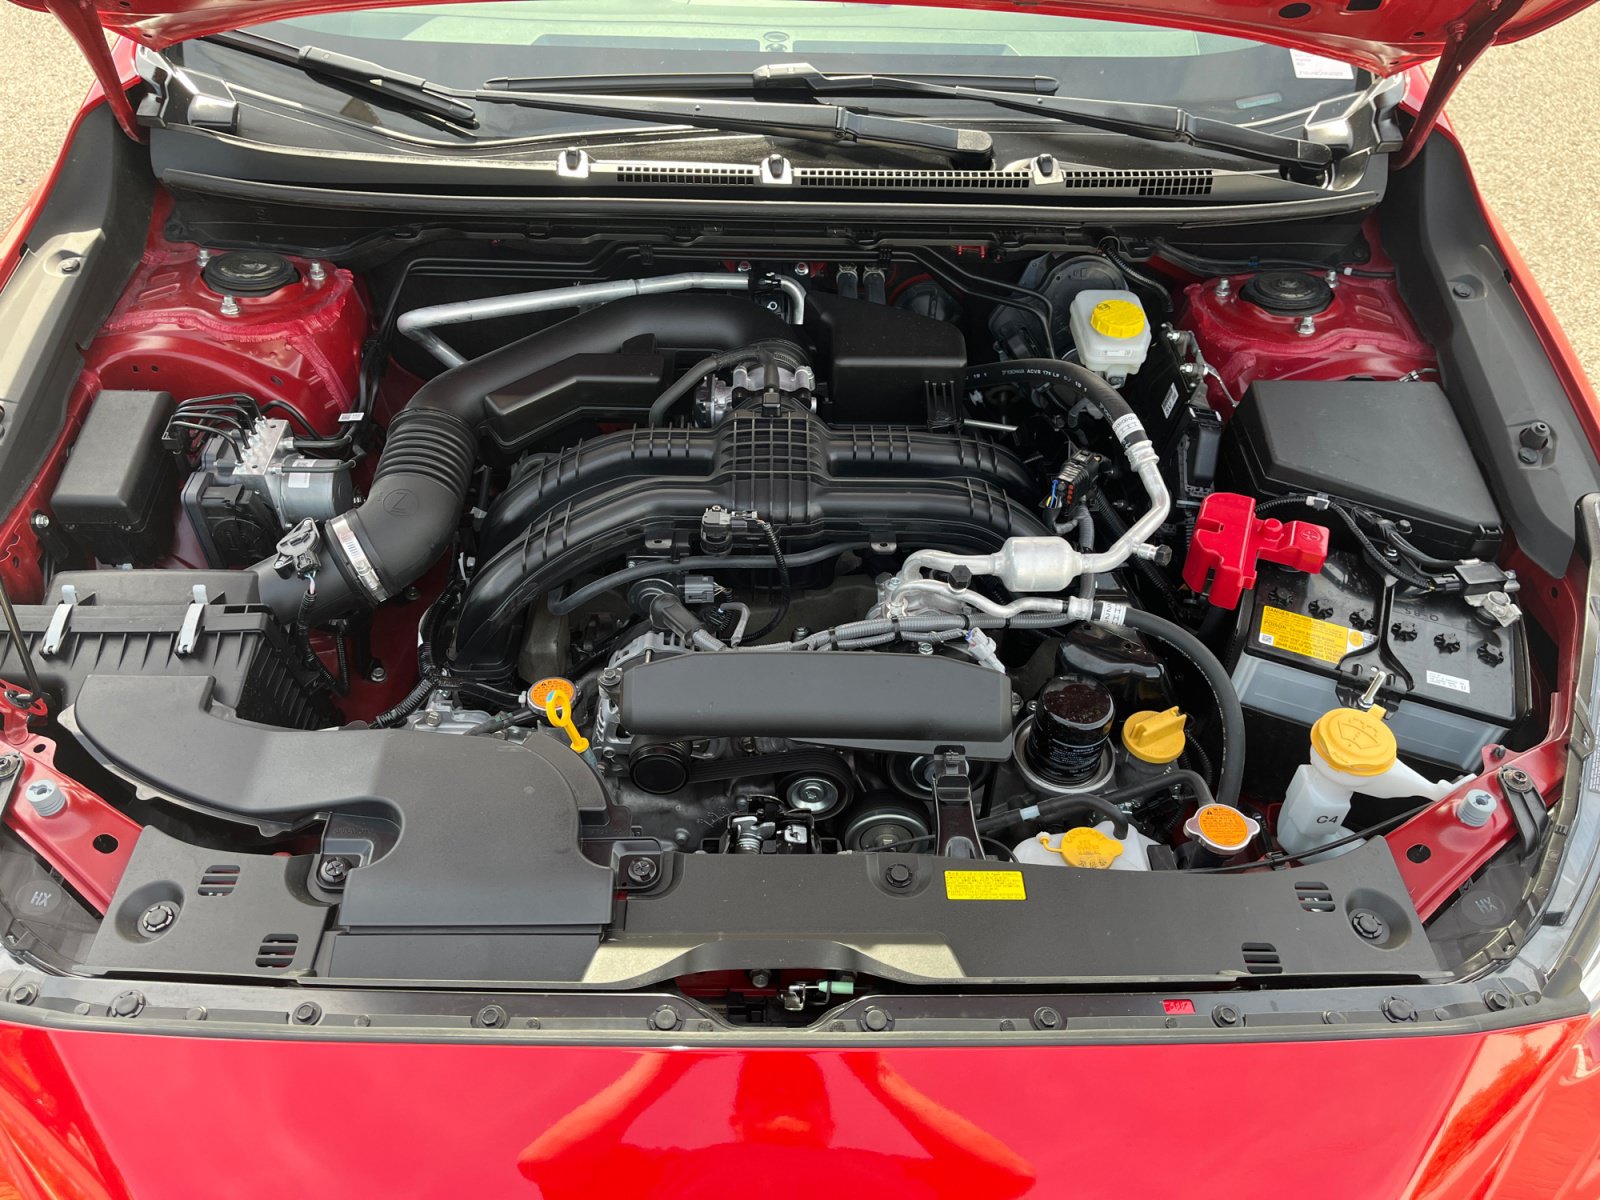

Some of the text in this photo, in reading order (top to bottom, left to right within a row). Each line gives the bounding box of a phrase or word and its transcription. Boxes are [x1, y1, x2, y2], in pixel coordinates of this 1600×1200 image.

[1316, 815, 1339, 824] C4
[30, 890, 52, 907] HX
[1474, 896, 1498, 914] HX
